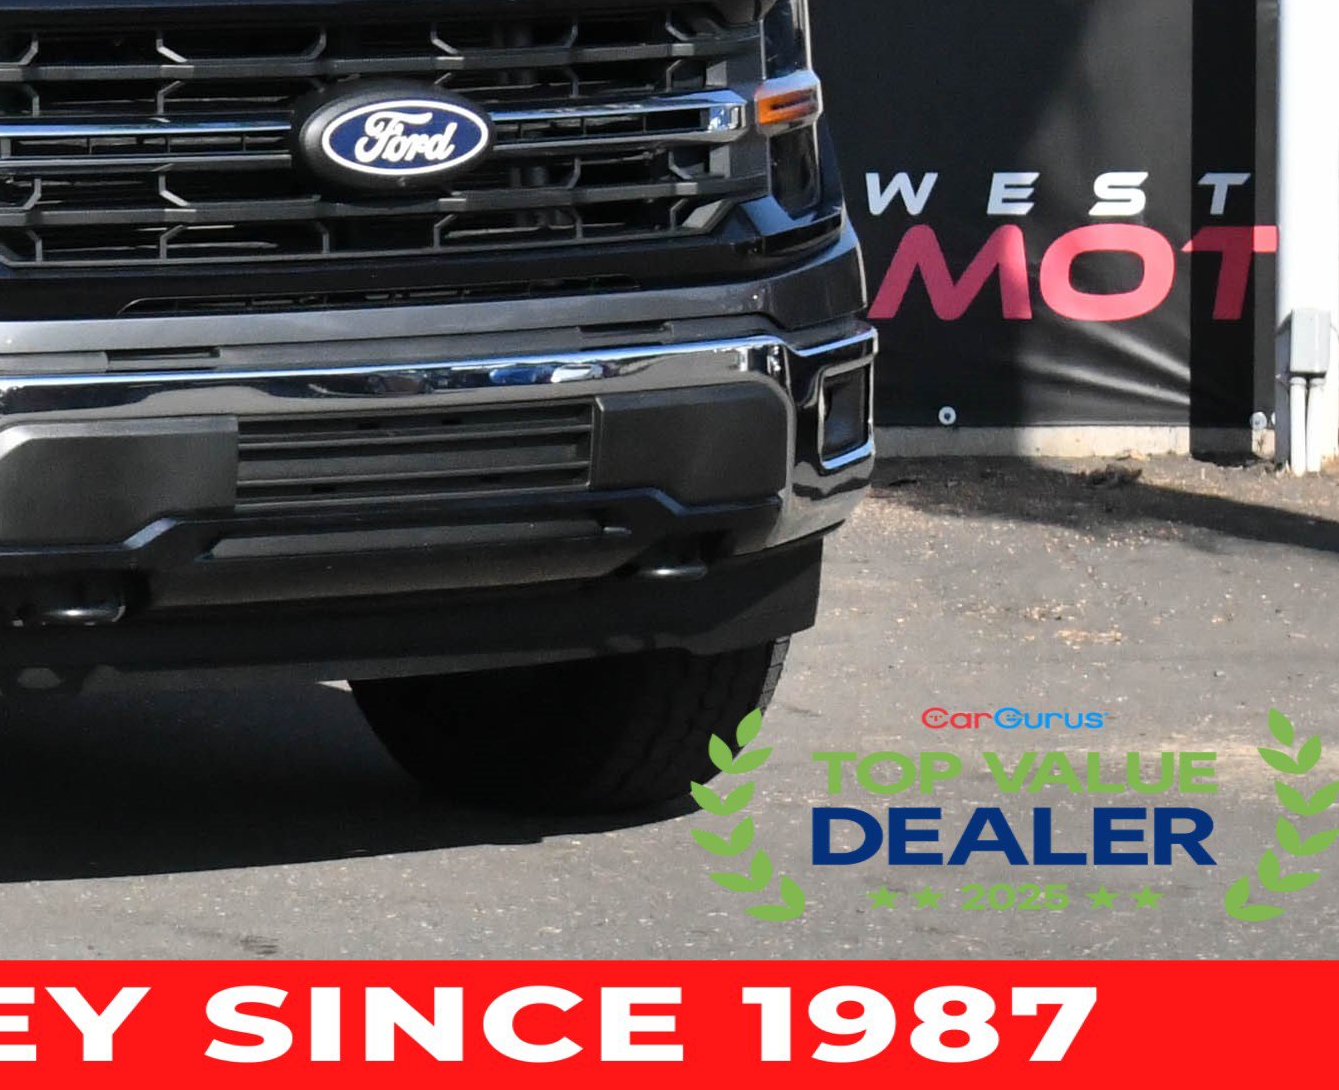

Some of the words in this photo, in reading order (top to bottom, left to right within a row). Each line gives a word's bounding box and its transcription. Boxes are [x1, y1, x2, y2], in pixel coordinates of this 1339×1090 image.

[354, 111, 458, 162] Ford
[866, 172, 1252, 216] WEST
[867, 224, 1279, 320] MOT
